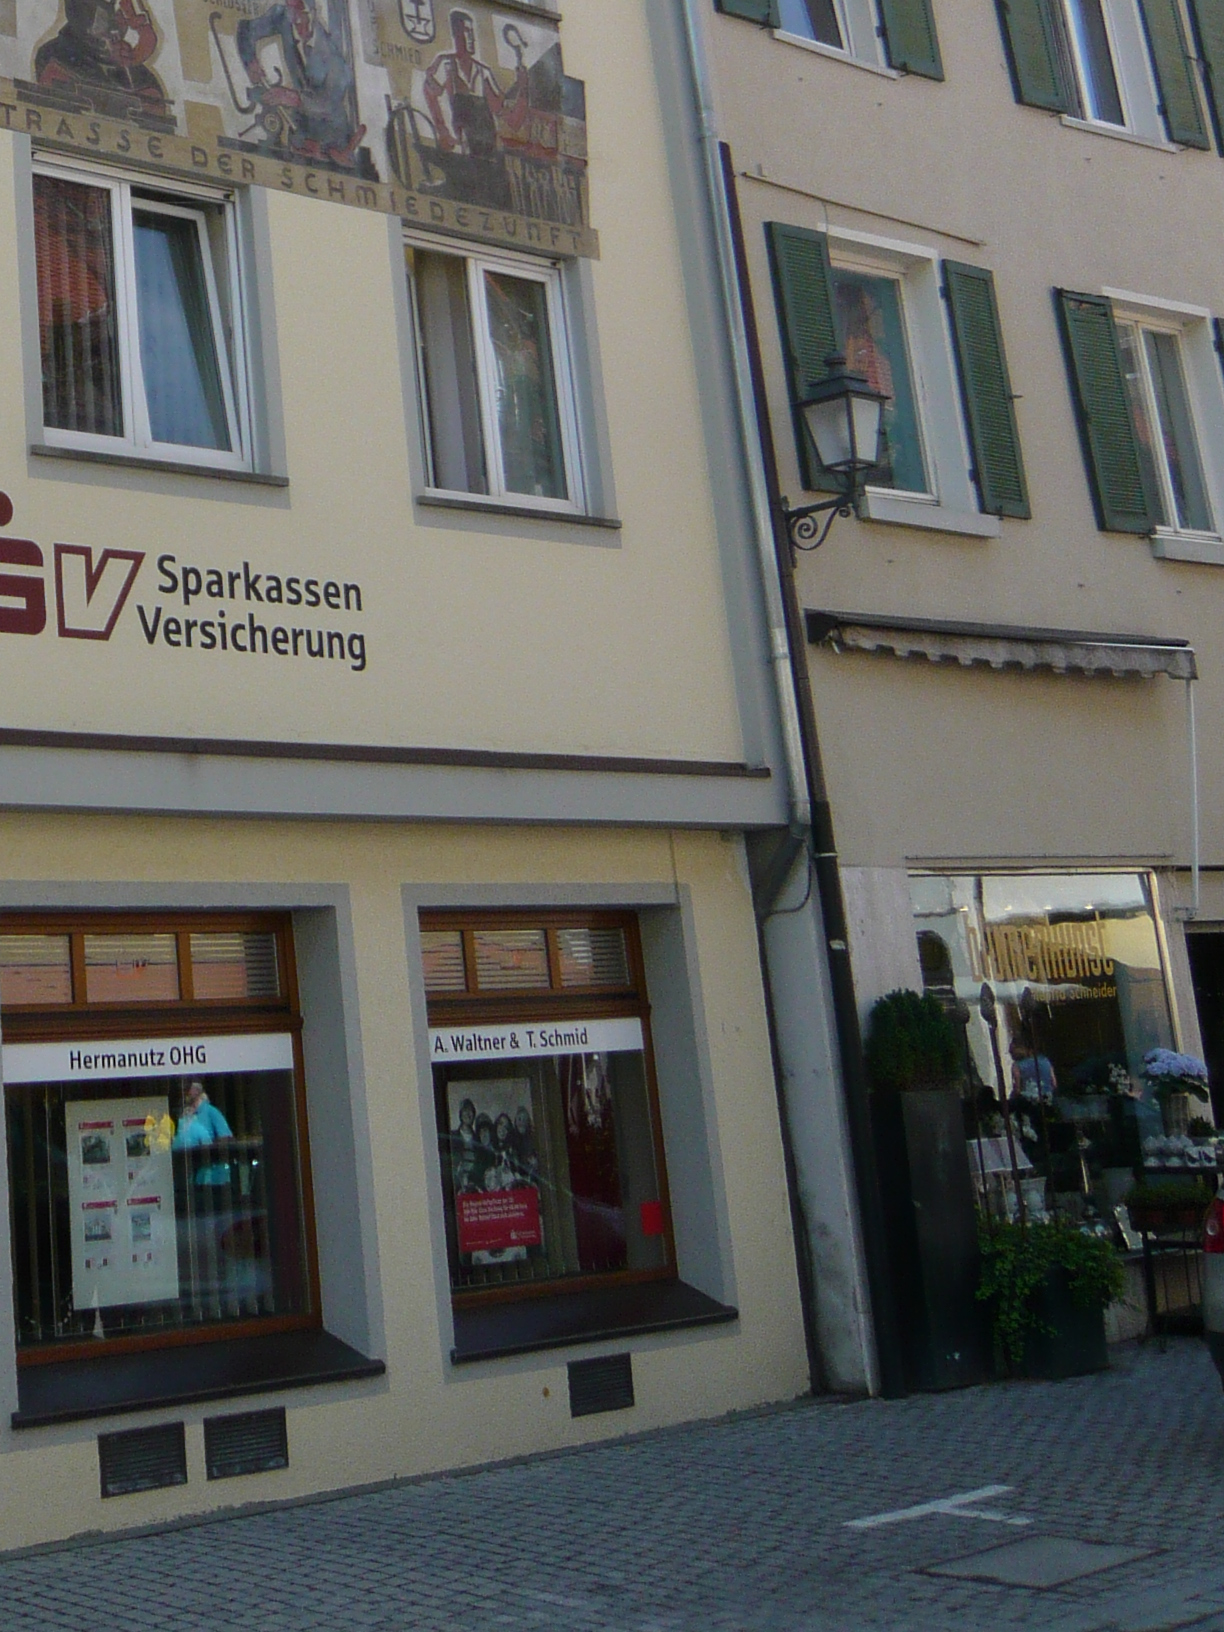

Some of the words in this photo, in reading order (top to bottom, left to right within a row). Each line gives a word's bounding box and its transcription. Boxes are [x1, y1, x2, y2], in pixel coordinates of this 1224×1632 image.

[191, 145, 256, 180] DER
[156, 553, 364, 612] Sparkassen
[136, 603, 367, 672] Versicherung
[70, 1047, 166, 1070] Hermanutz
[169, 1044, 208, 1066] OHG
[434, 1034, 448, 1053] A.
[450, 1032, 507, 1053] Waltner
[509, 1031, 521, 1050] &
[526, 1030, 537, 1048] T.
[539, 1026, 588, 1048] Schmid
